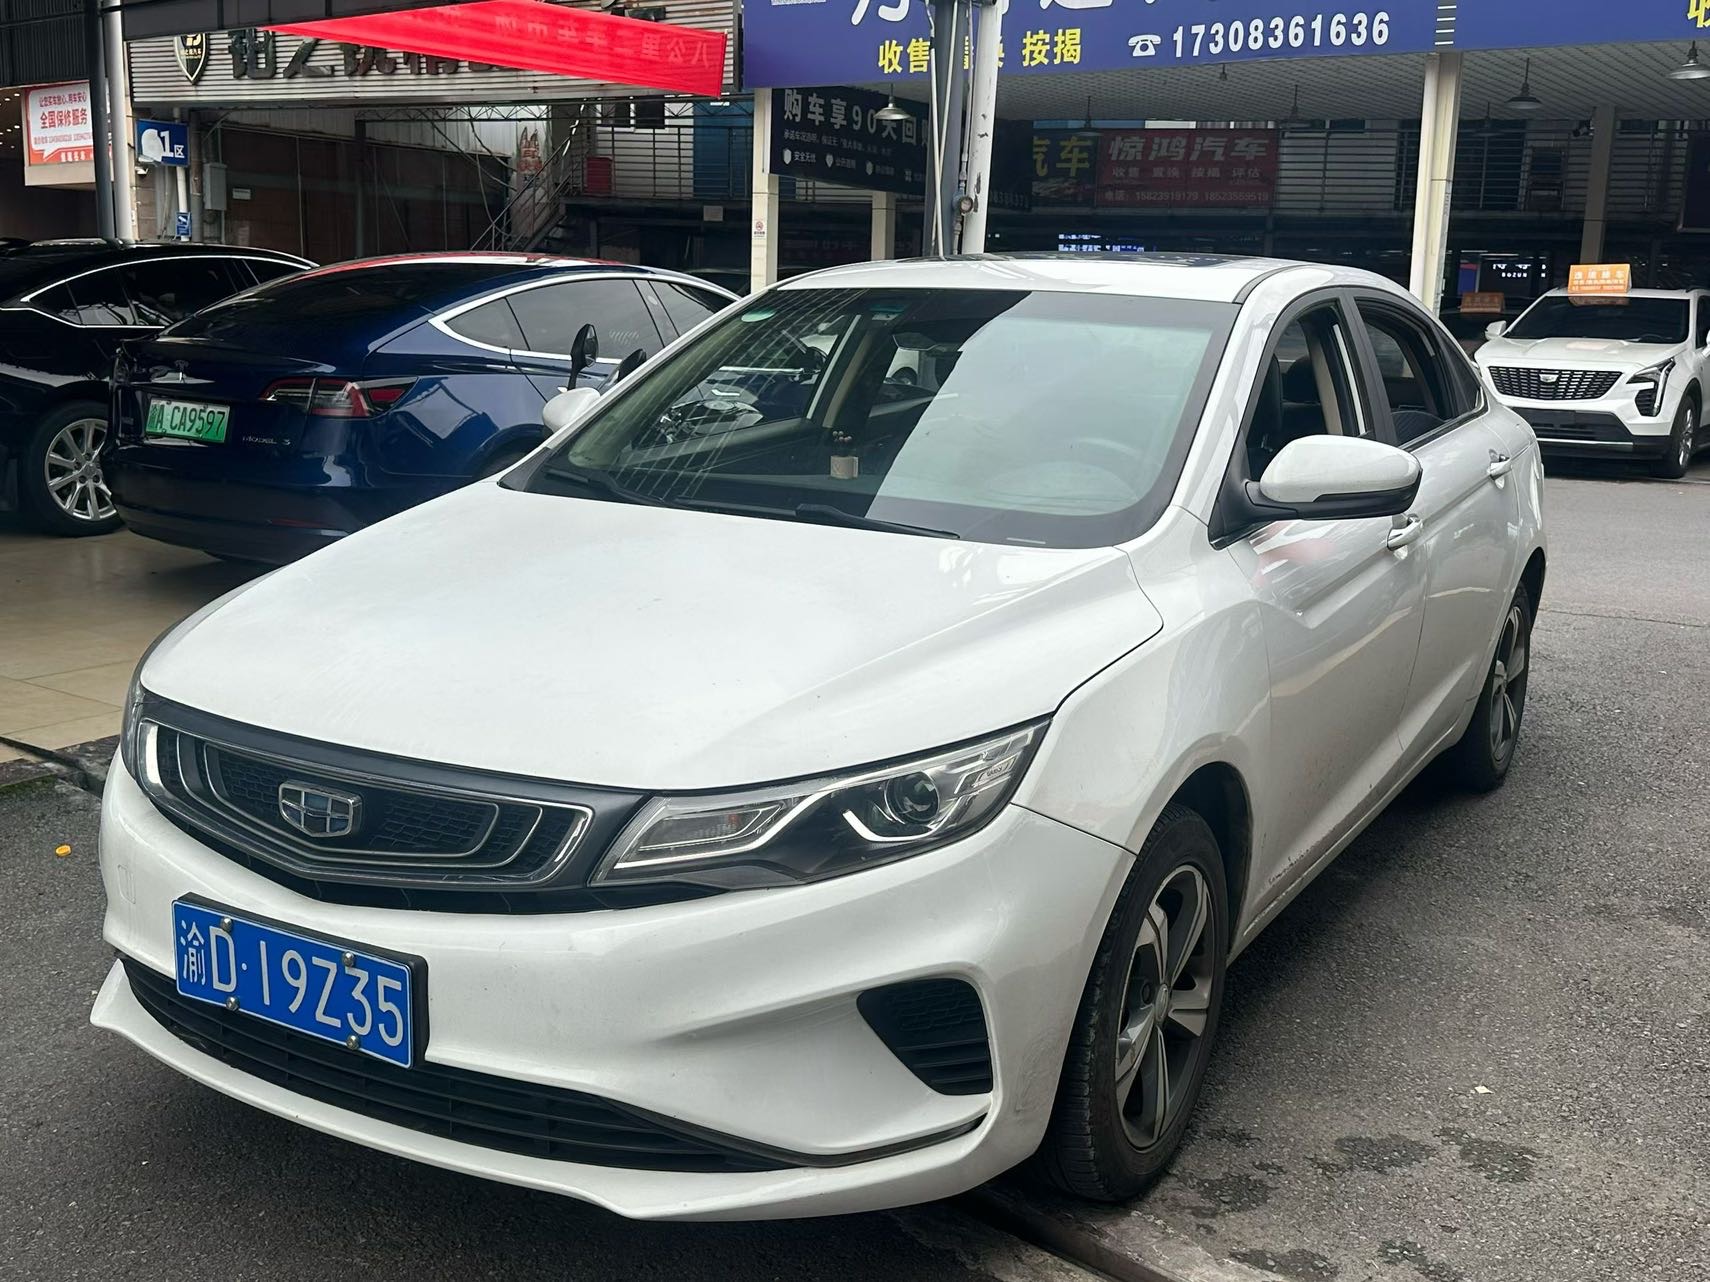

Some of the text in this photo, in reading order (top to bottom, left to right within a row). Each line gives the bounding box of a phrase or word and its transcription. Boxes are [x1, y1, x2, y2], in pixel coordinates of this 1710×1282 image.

[1022, 28, 1082, 67] 按揭
[1173, 12, 1390, 58] 17308361636
[40, 107, 88, 129] 全国保修服务
[1108, 136, 1269, 161] 惊鸿汽车
